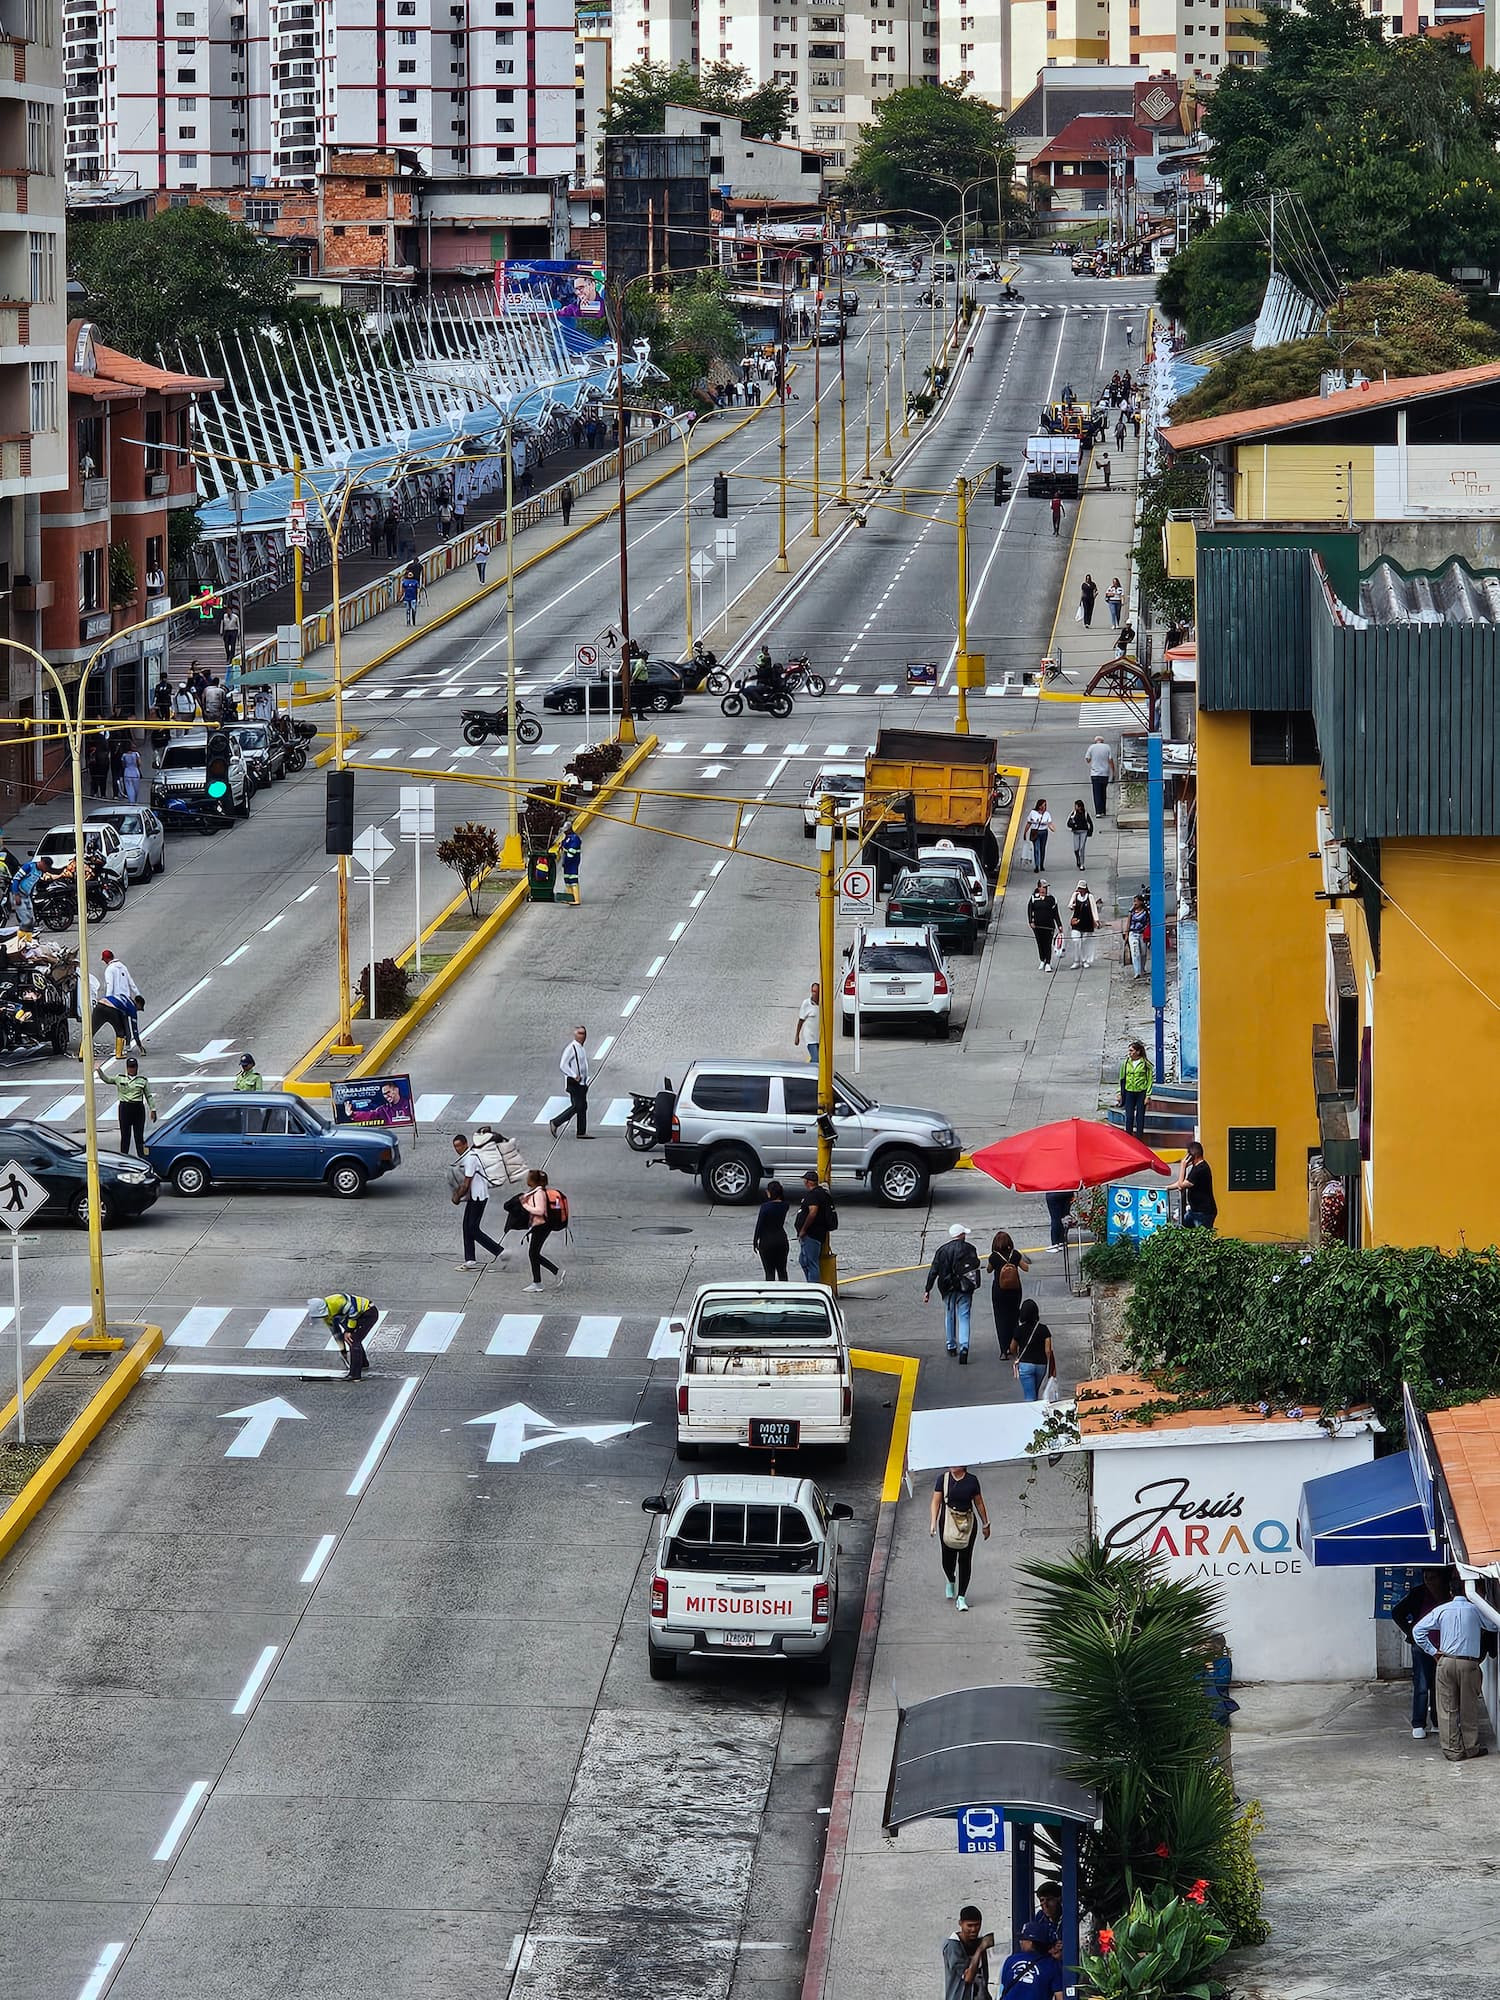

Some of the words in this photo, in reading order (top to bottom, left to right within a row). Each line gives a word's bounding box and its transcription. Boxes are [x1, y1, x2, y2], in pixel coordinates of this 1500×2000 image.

[851, 877, 862, 894] E
[759, 1423, 790, 1434] MOTO
[760, 1433, 788, 1445] TAXI
[1104, 1477, 1245, 1549] Jesús
[1149, 1520, 1303, 1556] ARAQ
[1196, 1560, 1302, 1577] ALCALDE
[686, 1596, 792, 1616] MITSUBISHI
[967, 1841, 996, 1853] BUS
